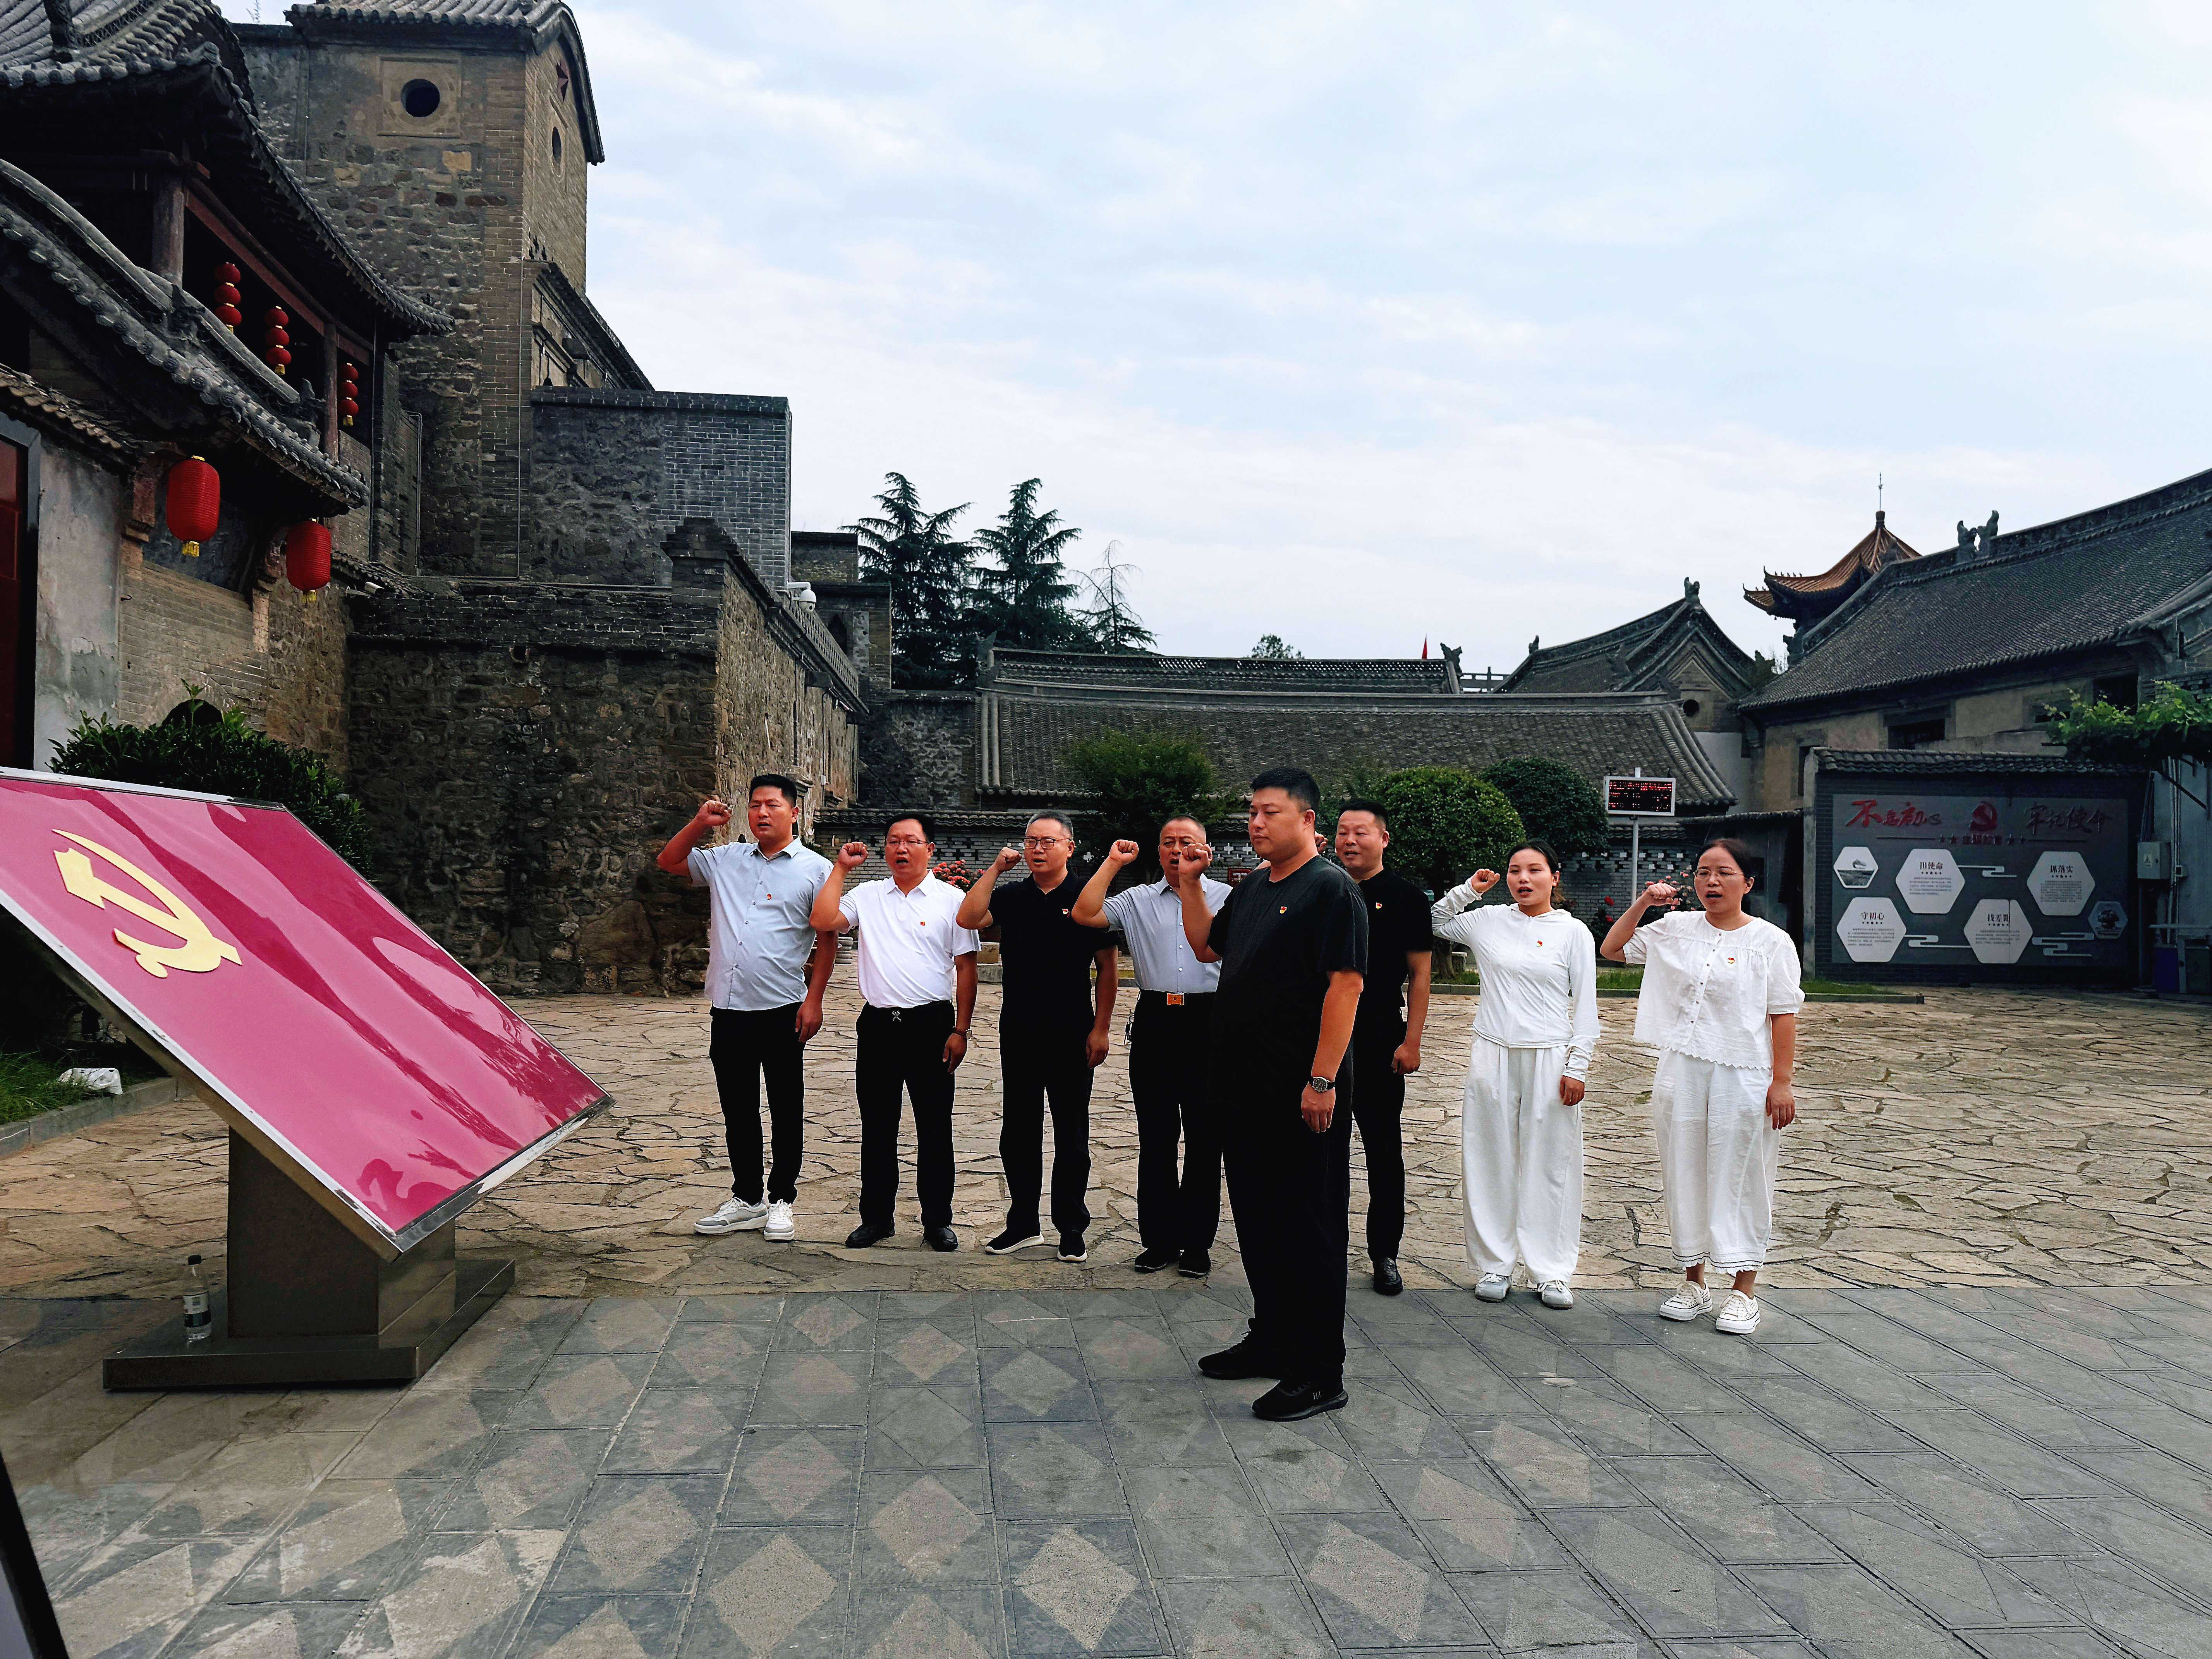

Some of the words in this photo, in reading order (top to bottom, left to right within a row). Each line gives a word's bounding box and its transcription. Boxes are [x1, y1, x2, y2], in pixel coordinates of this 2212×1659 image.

[1846, 799, 1942, 828] 不忘初心
[2025, 800, 2113, 835] 牢记使命
[1920, 861, 1943, 870] 担使命
[2050, 865, 2073, 874] 抓落实
[1861, 912, 1885, 920] 守初心
[1987, 914, 2010, 922] 找差距
